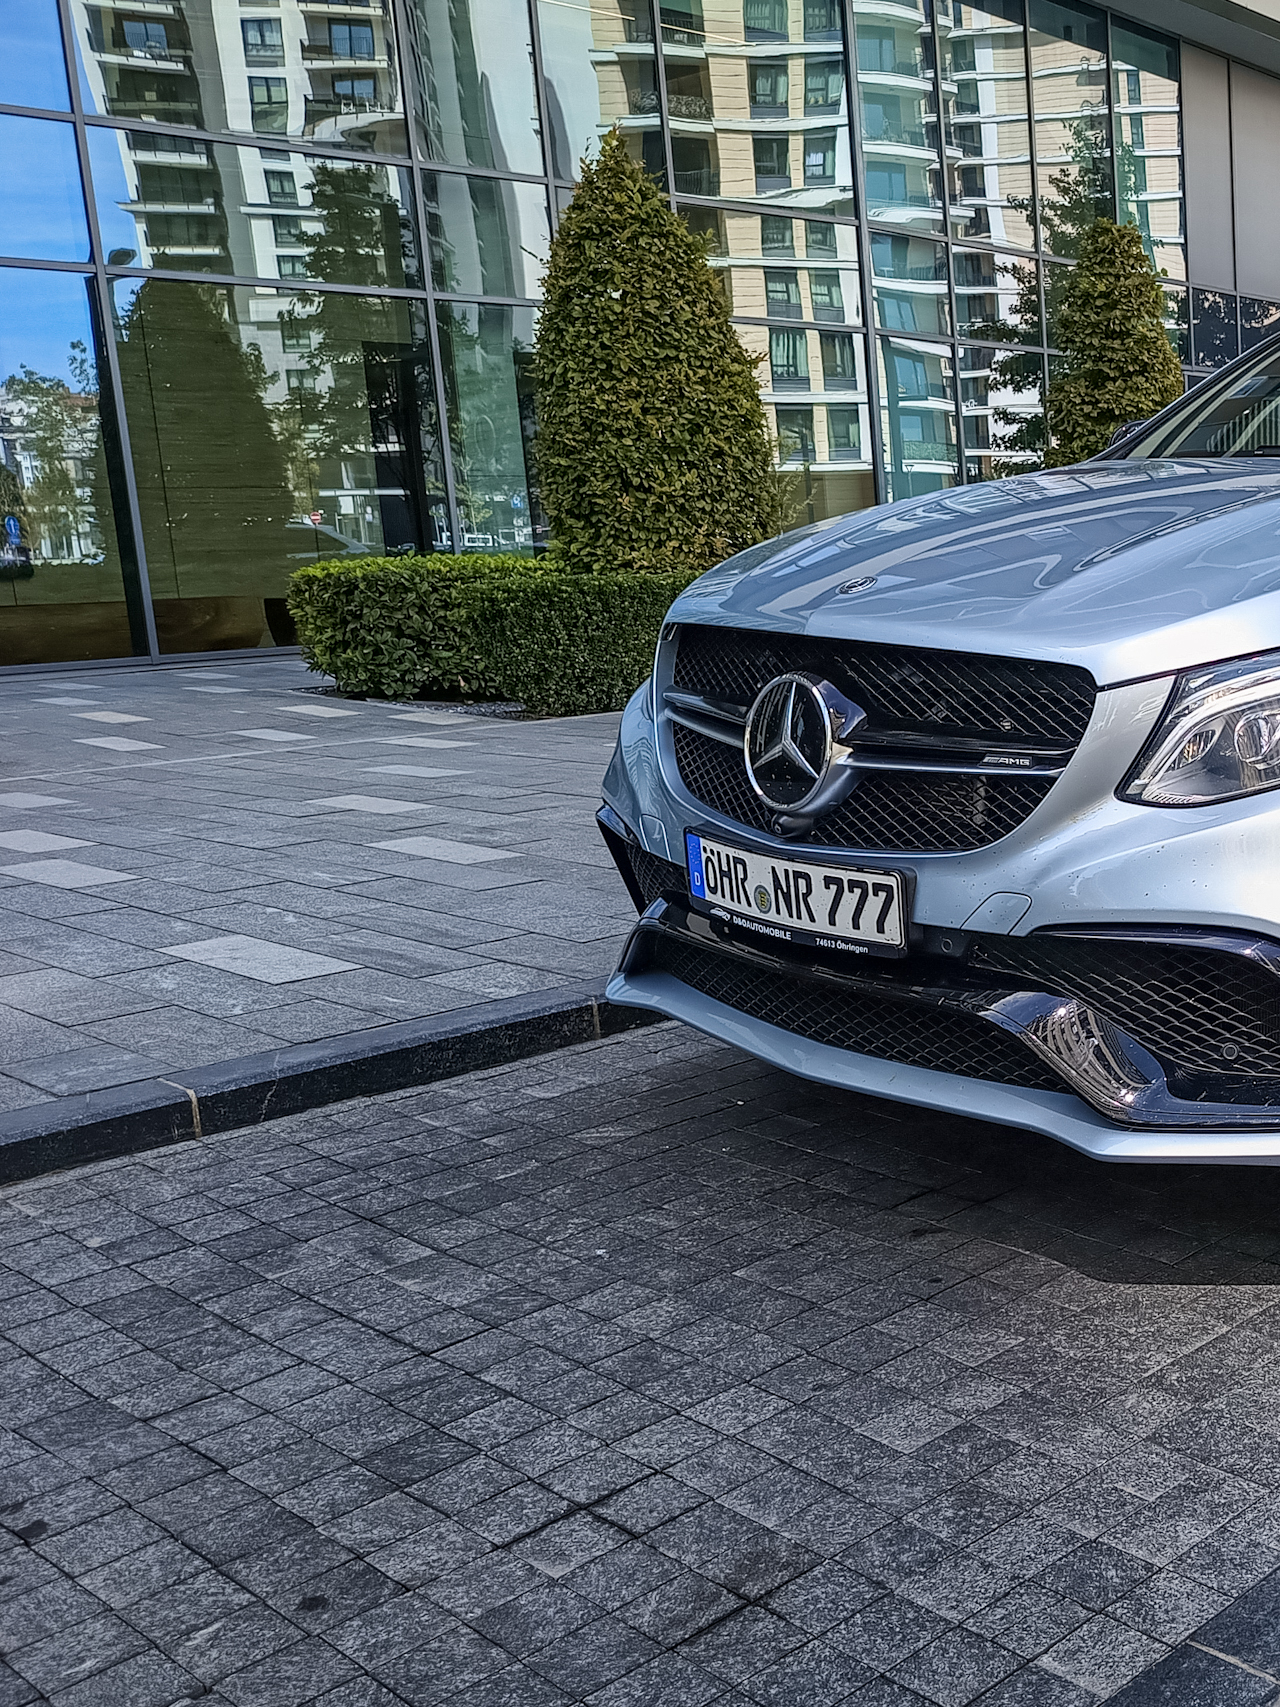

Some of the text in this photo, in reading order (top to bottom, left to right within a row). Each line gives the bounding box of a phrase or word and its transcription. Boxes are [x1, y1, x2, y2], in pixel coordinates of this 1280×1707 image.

[998, 757, 1030, 766] AMG
[694, 871, 701, 886] D
[702, 845, 895, 935] ÖHR NR 777
[815, 937, 836, 949] 74613
[836, 940, 869, 954] Öhringen
